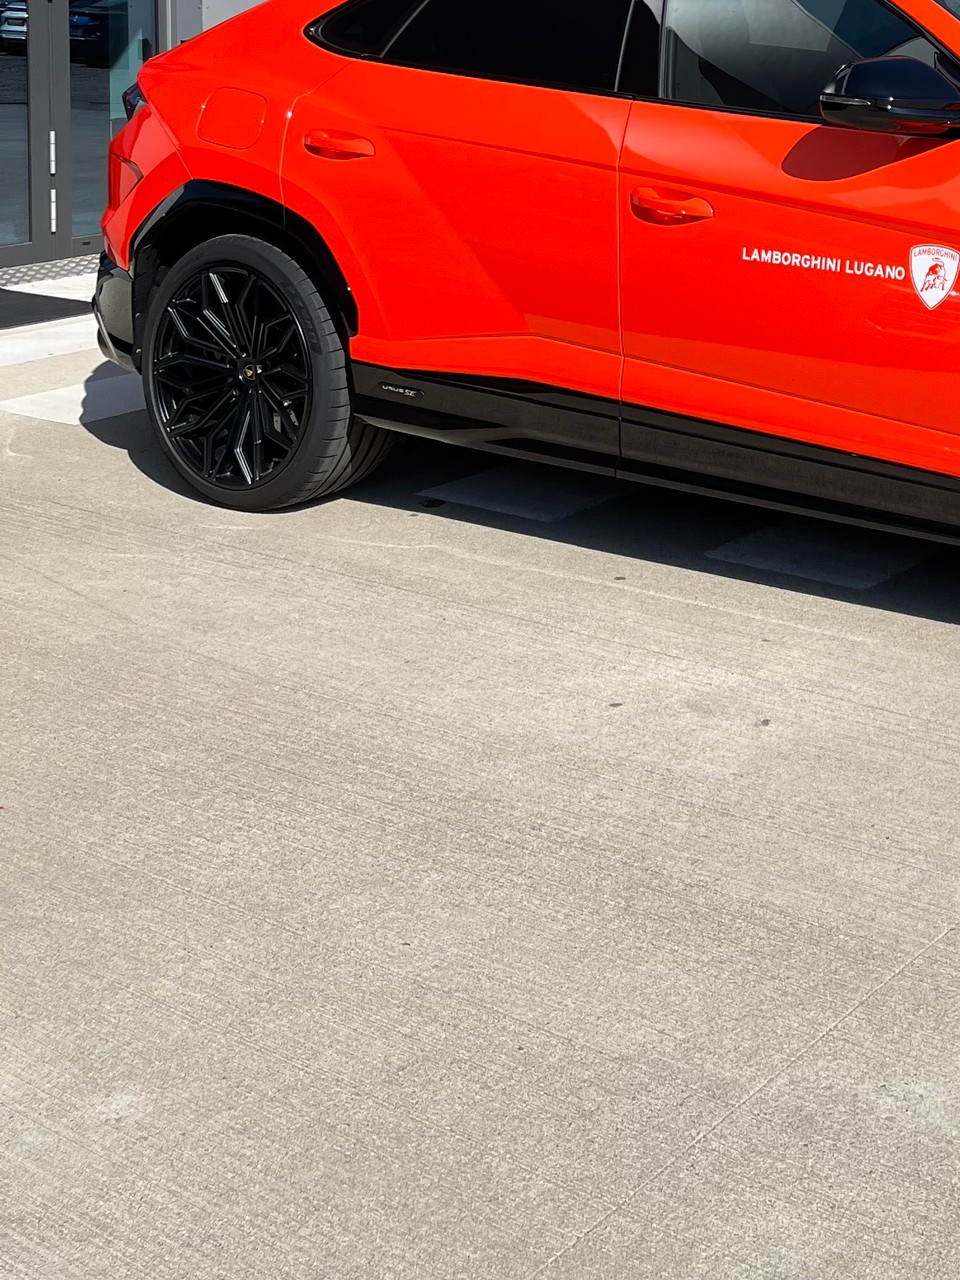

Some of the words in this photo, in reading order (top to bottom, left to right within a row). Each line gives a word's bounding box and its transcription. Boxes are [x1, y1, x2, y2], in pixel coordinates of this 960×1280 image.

[741, 246, 841, 272] LAMBORGHINI
[845, 259, 906, 280] LUGANO
[913, 248, 958, 262] LAMBORGHINI
